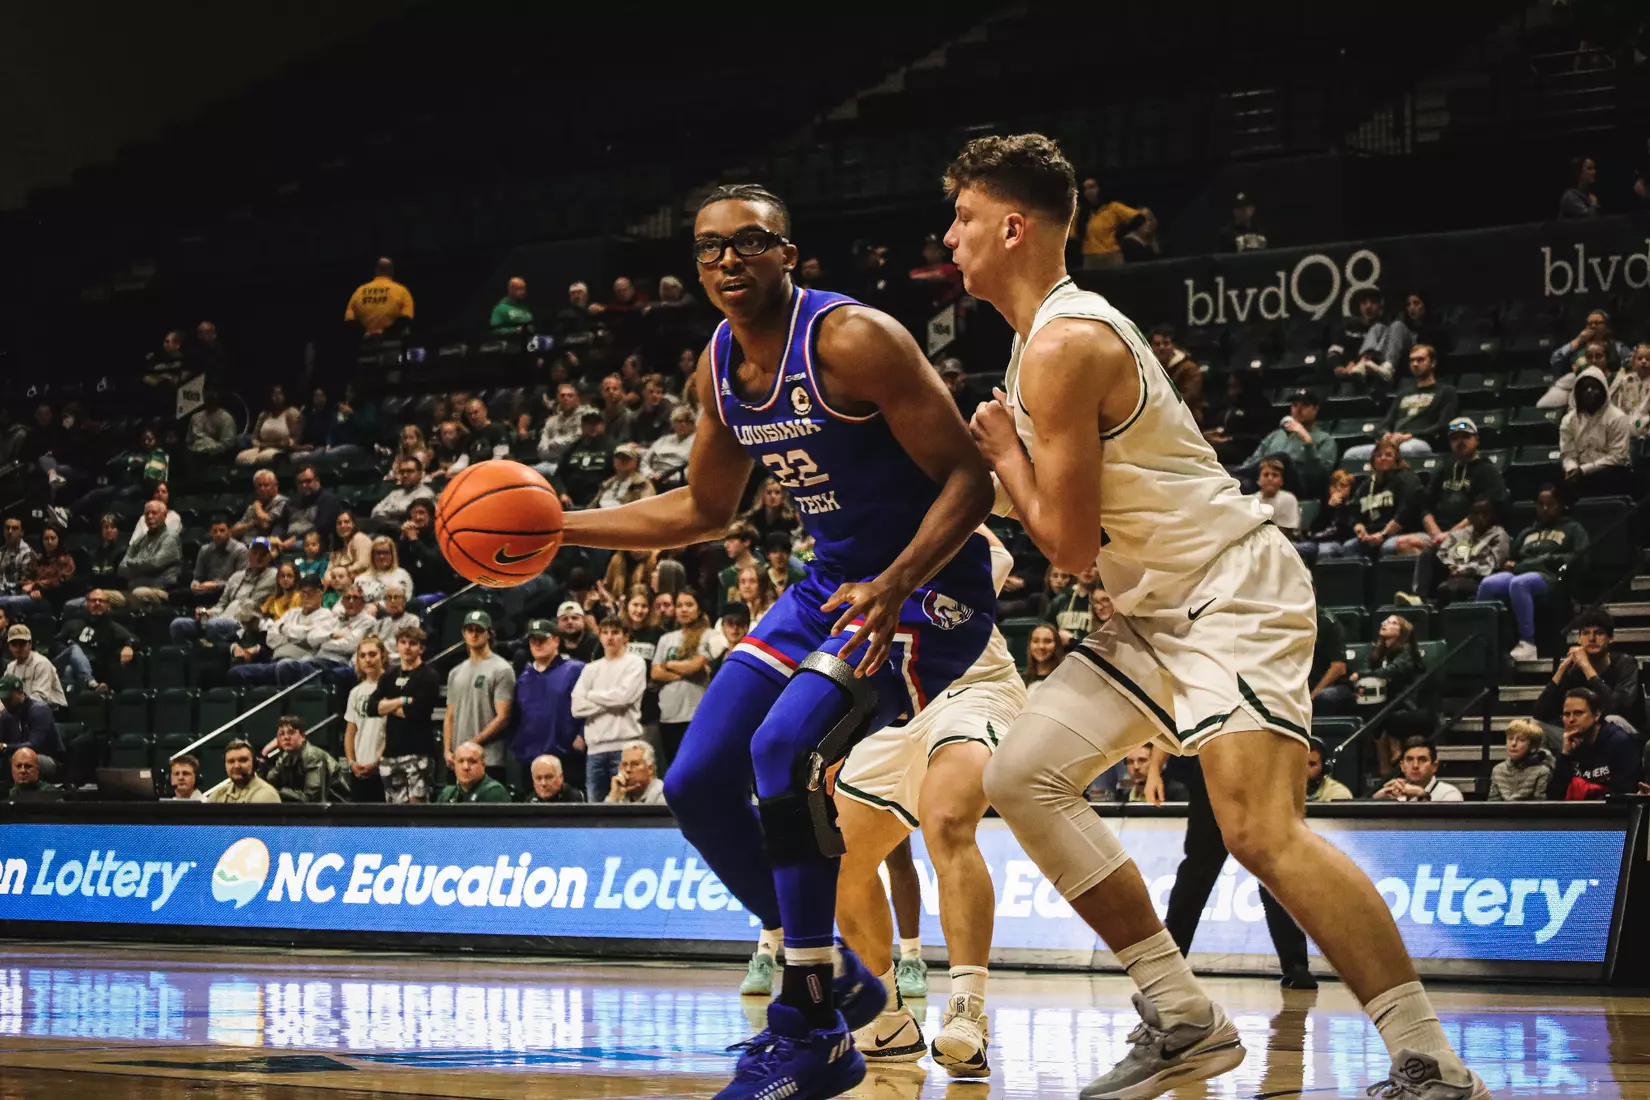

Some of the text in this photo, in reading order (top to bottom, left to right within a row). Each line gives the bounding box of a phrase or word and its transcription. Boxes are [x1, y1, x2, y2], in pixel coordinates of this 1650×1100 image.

[362, 287, 390, 296] EVENT
[362, 296, 388, 305] STAFF
[733, 417, 822, 446] LOUISIANA
[761, 448, 830, 488] 22
[793, 490, 842, 515] TECH
[31, 849, 191, 912] Lottery
[266, 852, 762, 927] NC Education Lotte
[1375, 864, 1588, 945] ottery
